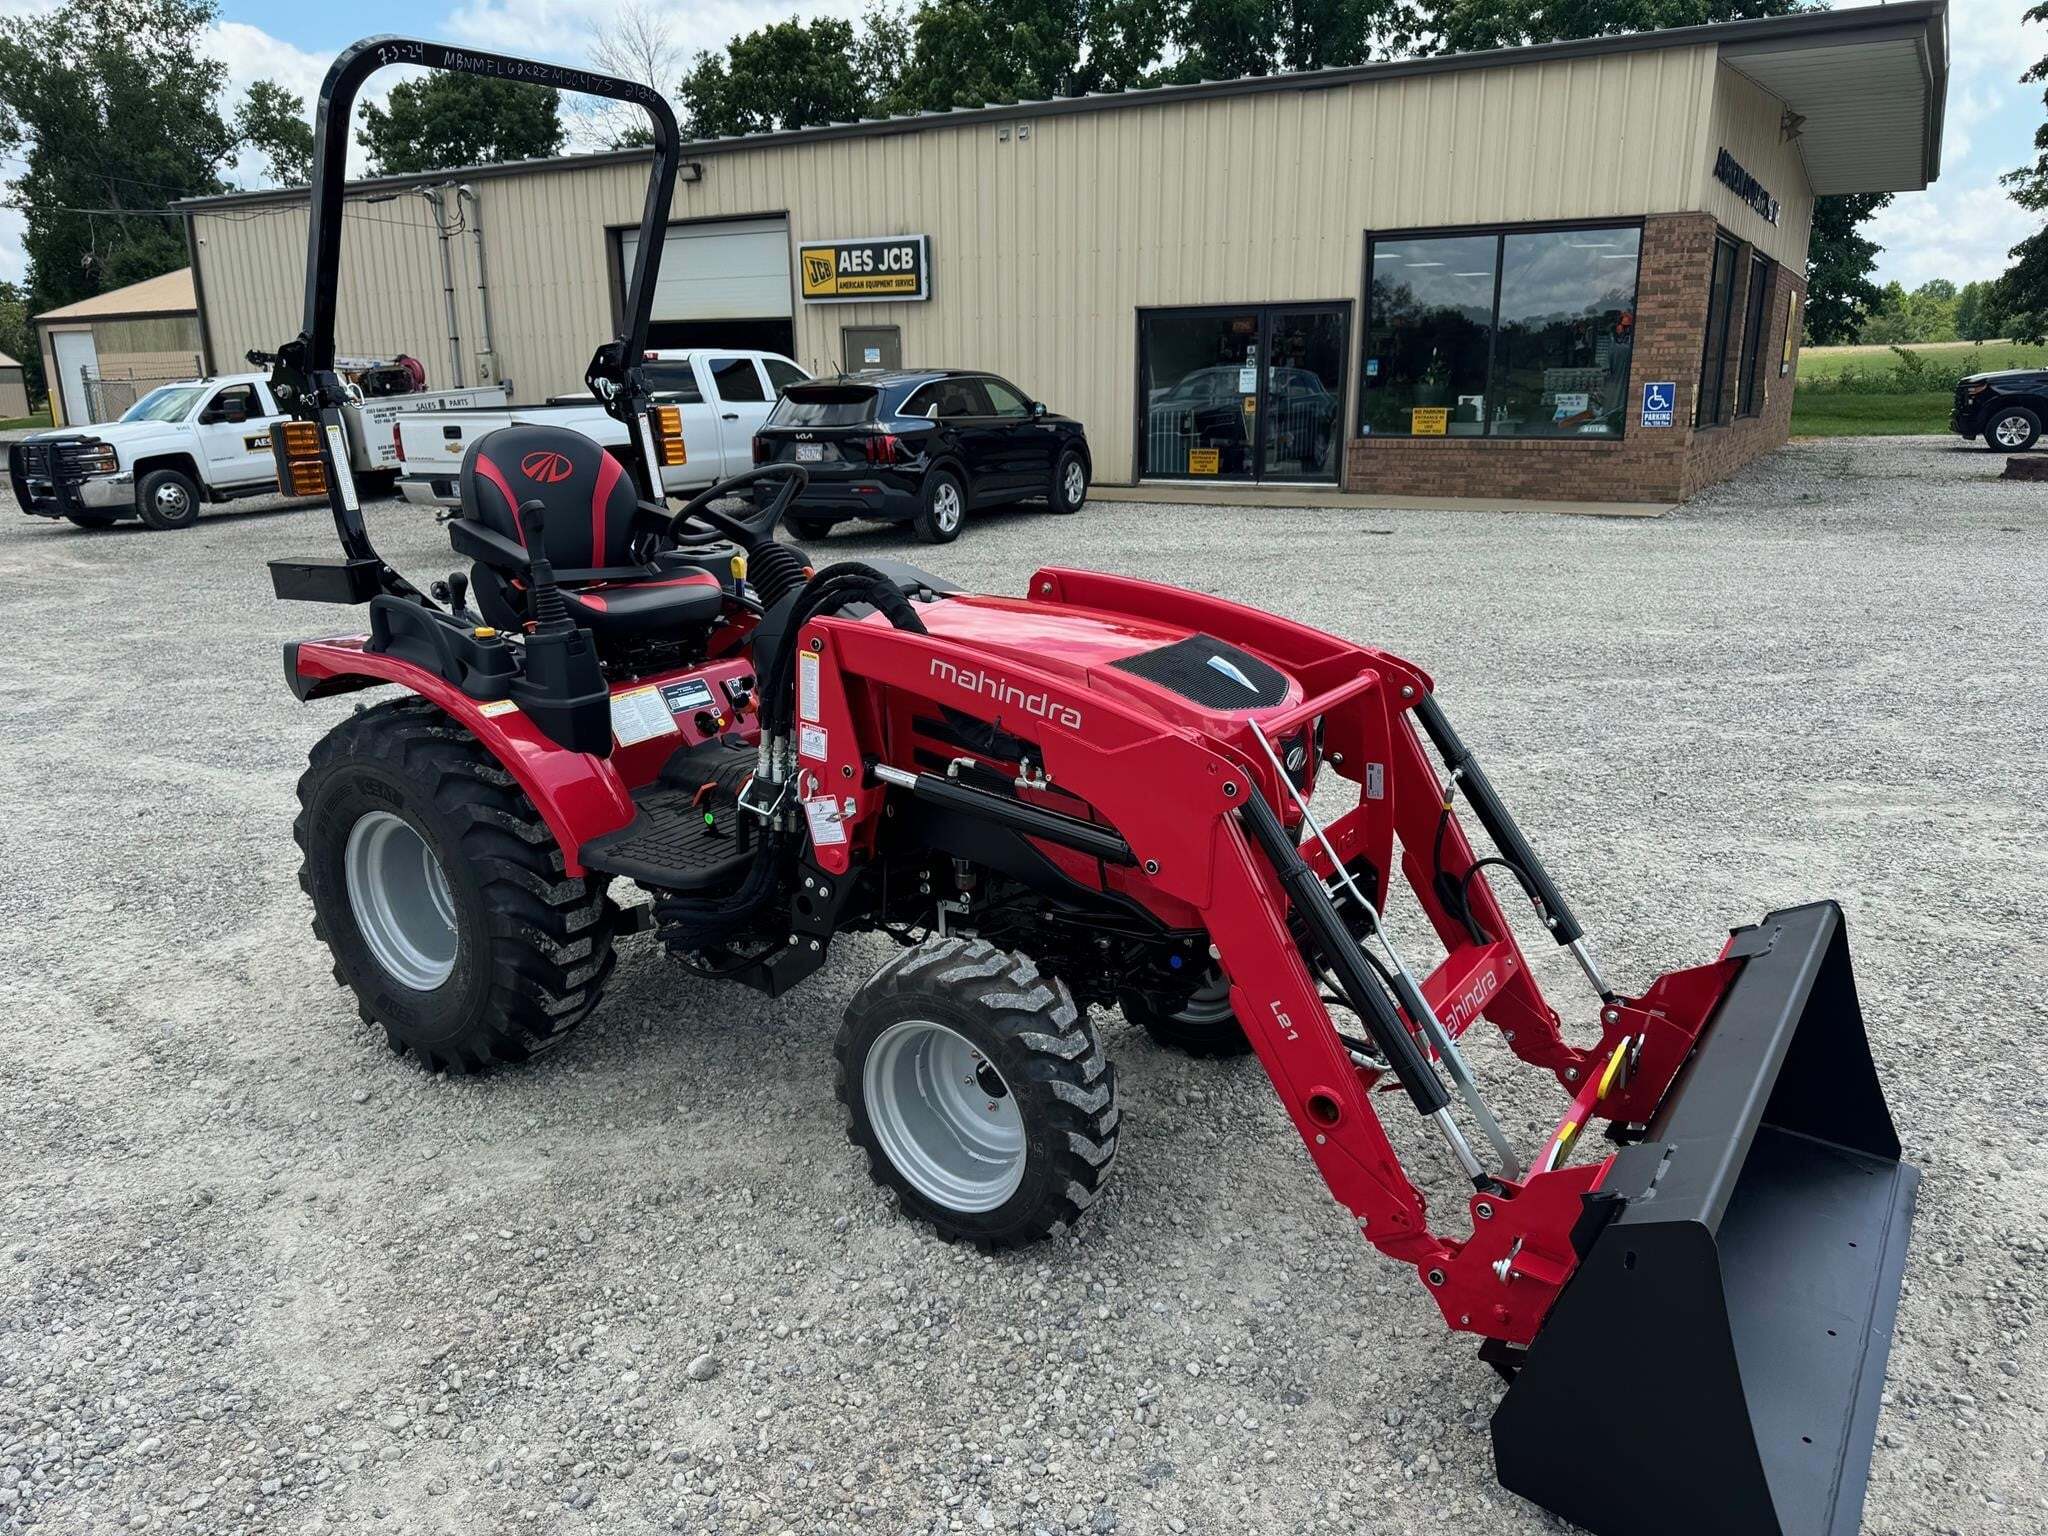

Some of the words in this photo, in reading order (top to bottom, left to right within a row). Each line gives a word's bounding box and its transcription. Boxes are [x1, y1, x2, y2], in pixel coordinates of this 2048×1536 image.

[809, 260, 833, 284] JCB
[839, 249, 874, 273] AES
[878, 247, 914, 272] JCB
[839, 281, 865, 290] AMERICAN
[865, 279, 894, 290] EQUIPMENT
[894, 278, 915, 288] SERVICE
[415, 401, 437, 412] SALES
[448, 398, 469, 407] PARTS
[1644, 413, 1671, 421] PARKING
[254, 438, 273, 448] AES
[929, 657, 1083, 731] mahindra
[1441, 970, 1497, 1038] ahindra
[1269, 999, 1299, 1042] L21
